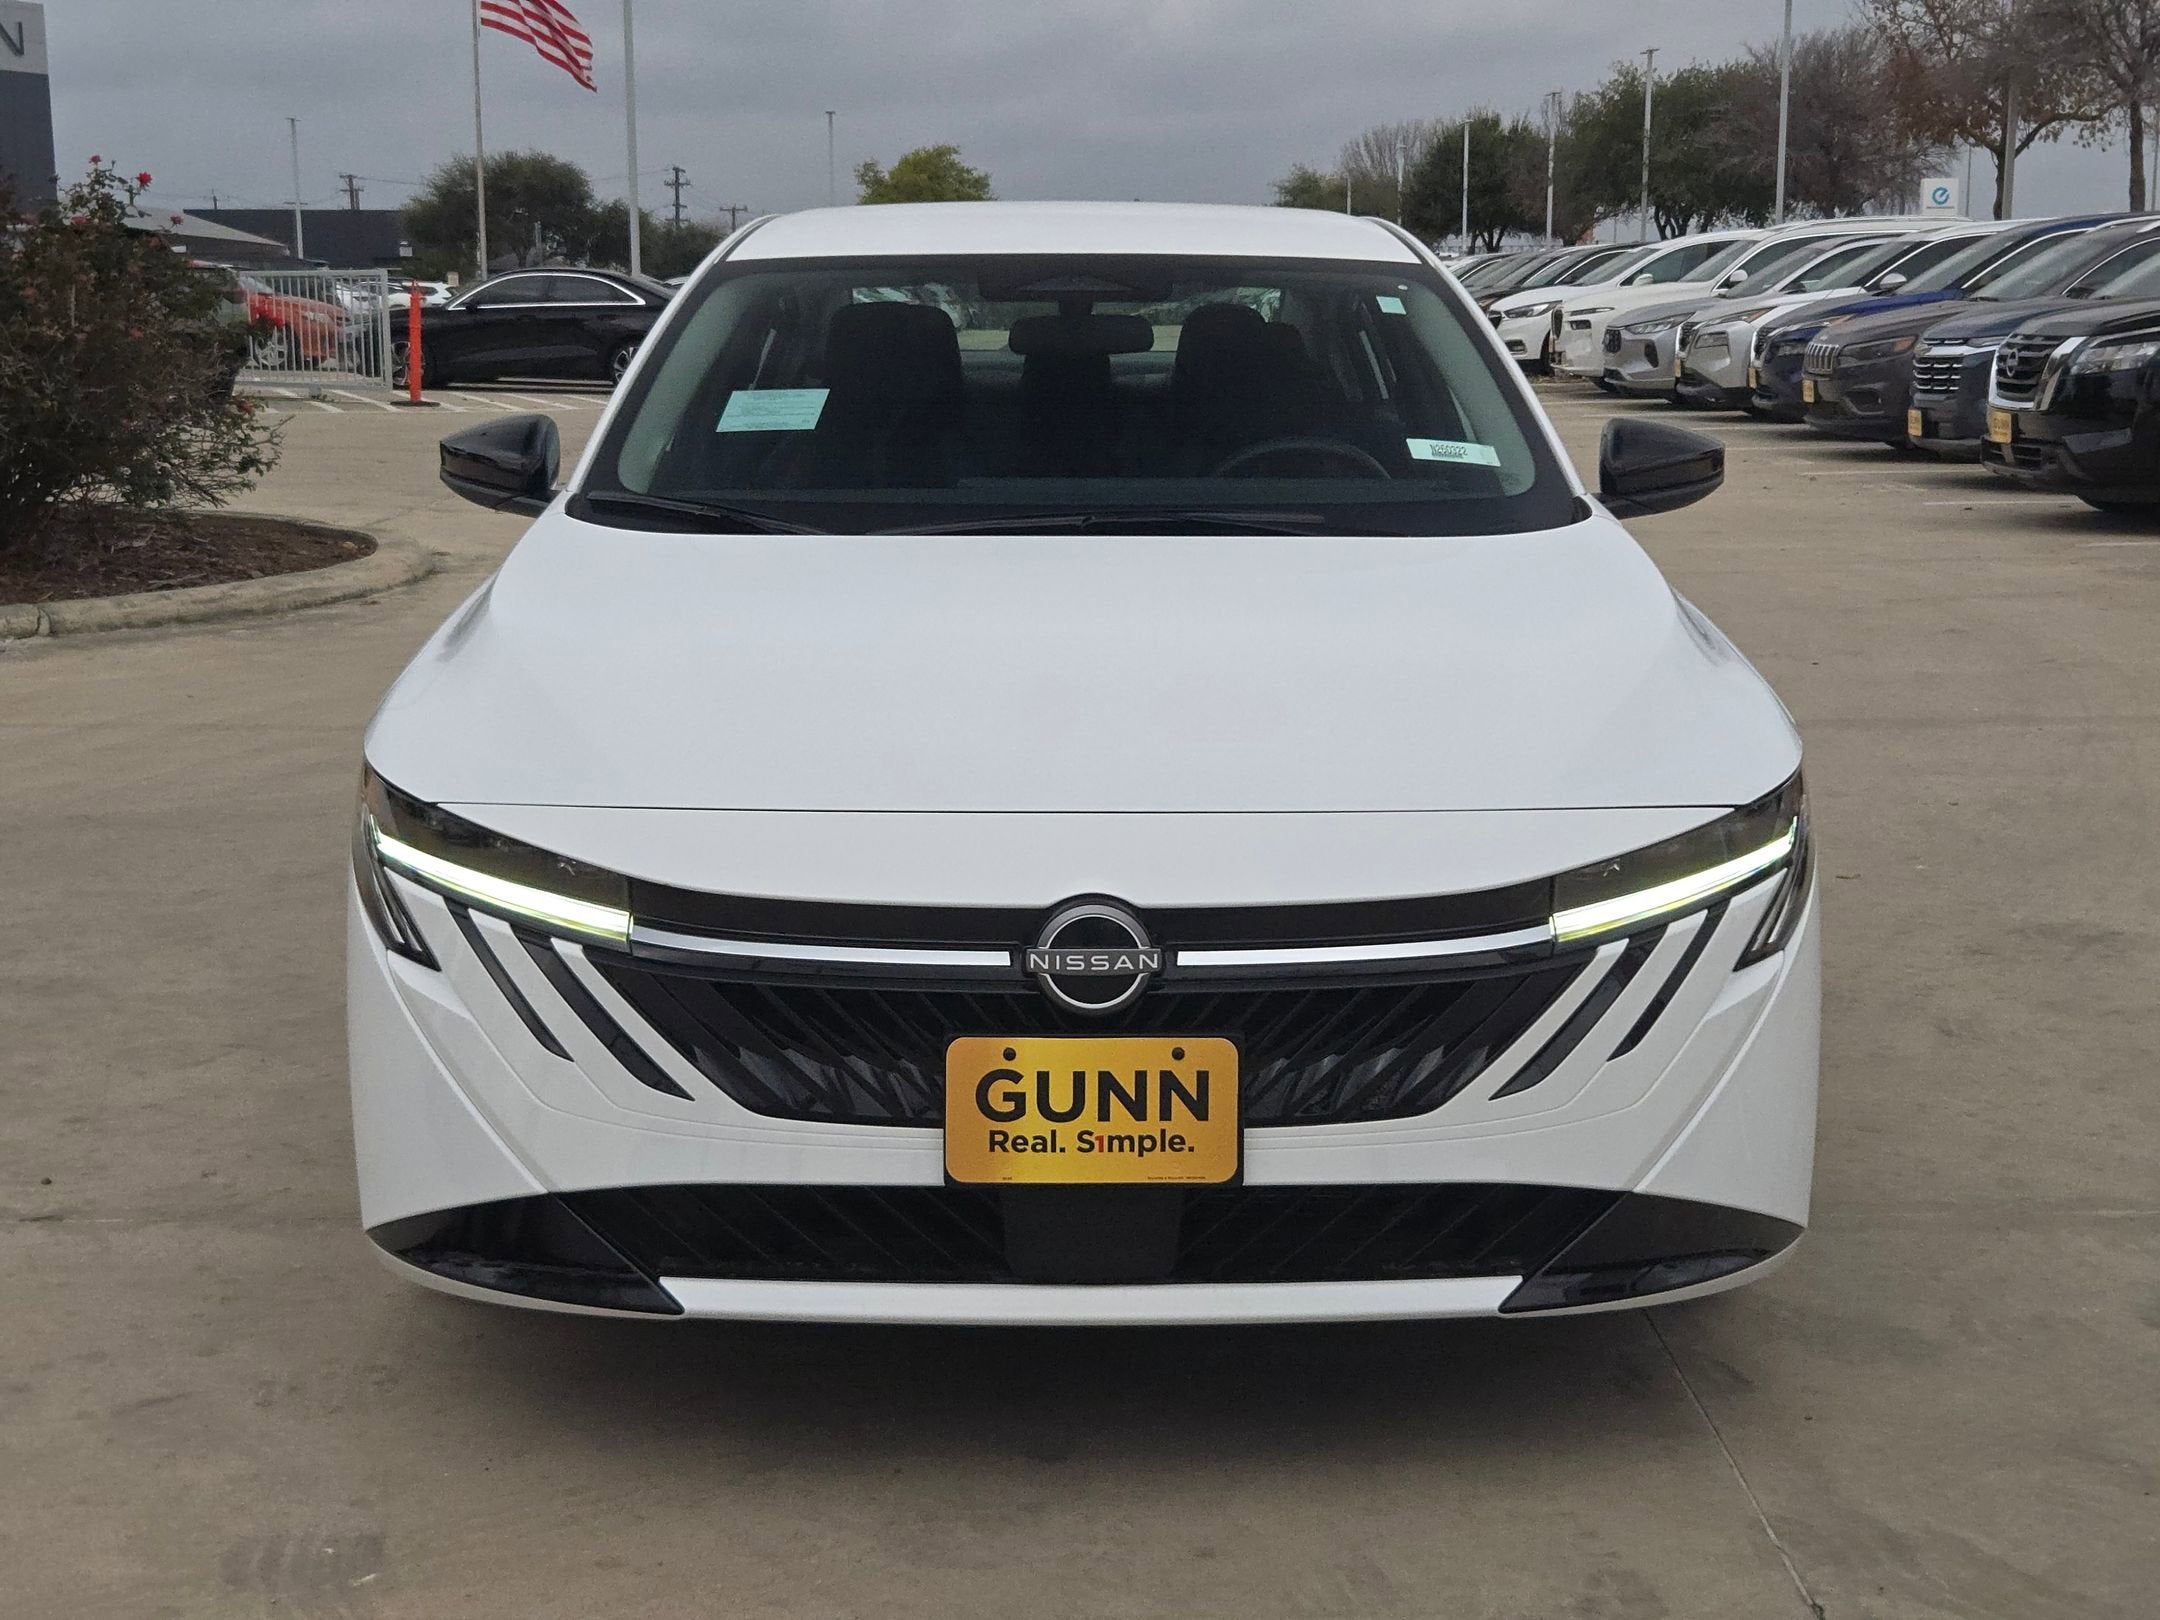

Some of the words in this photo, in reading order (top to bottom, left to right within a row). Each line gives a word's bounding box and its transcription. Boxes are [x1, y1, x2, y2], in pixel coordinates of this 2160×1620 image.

[1029, 953, 1158, 971] NISSAN
[975, 1068, 1210, 1123] GUNN
[989, 1129, 1066, 1153] Real.
